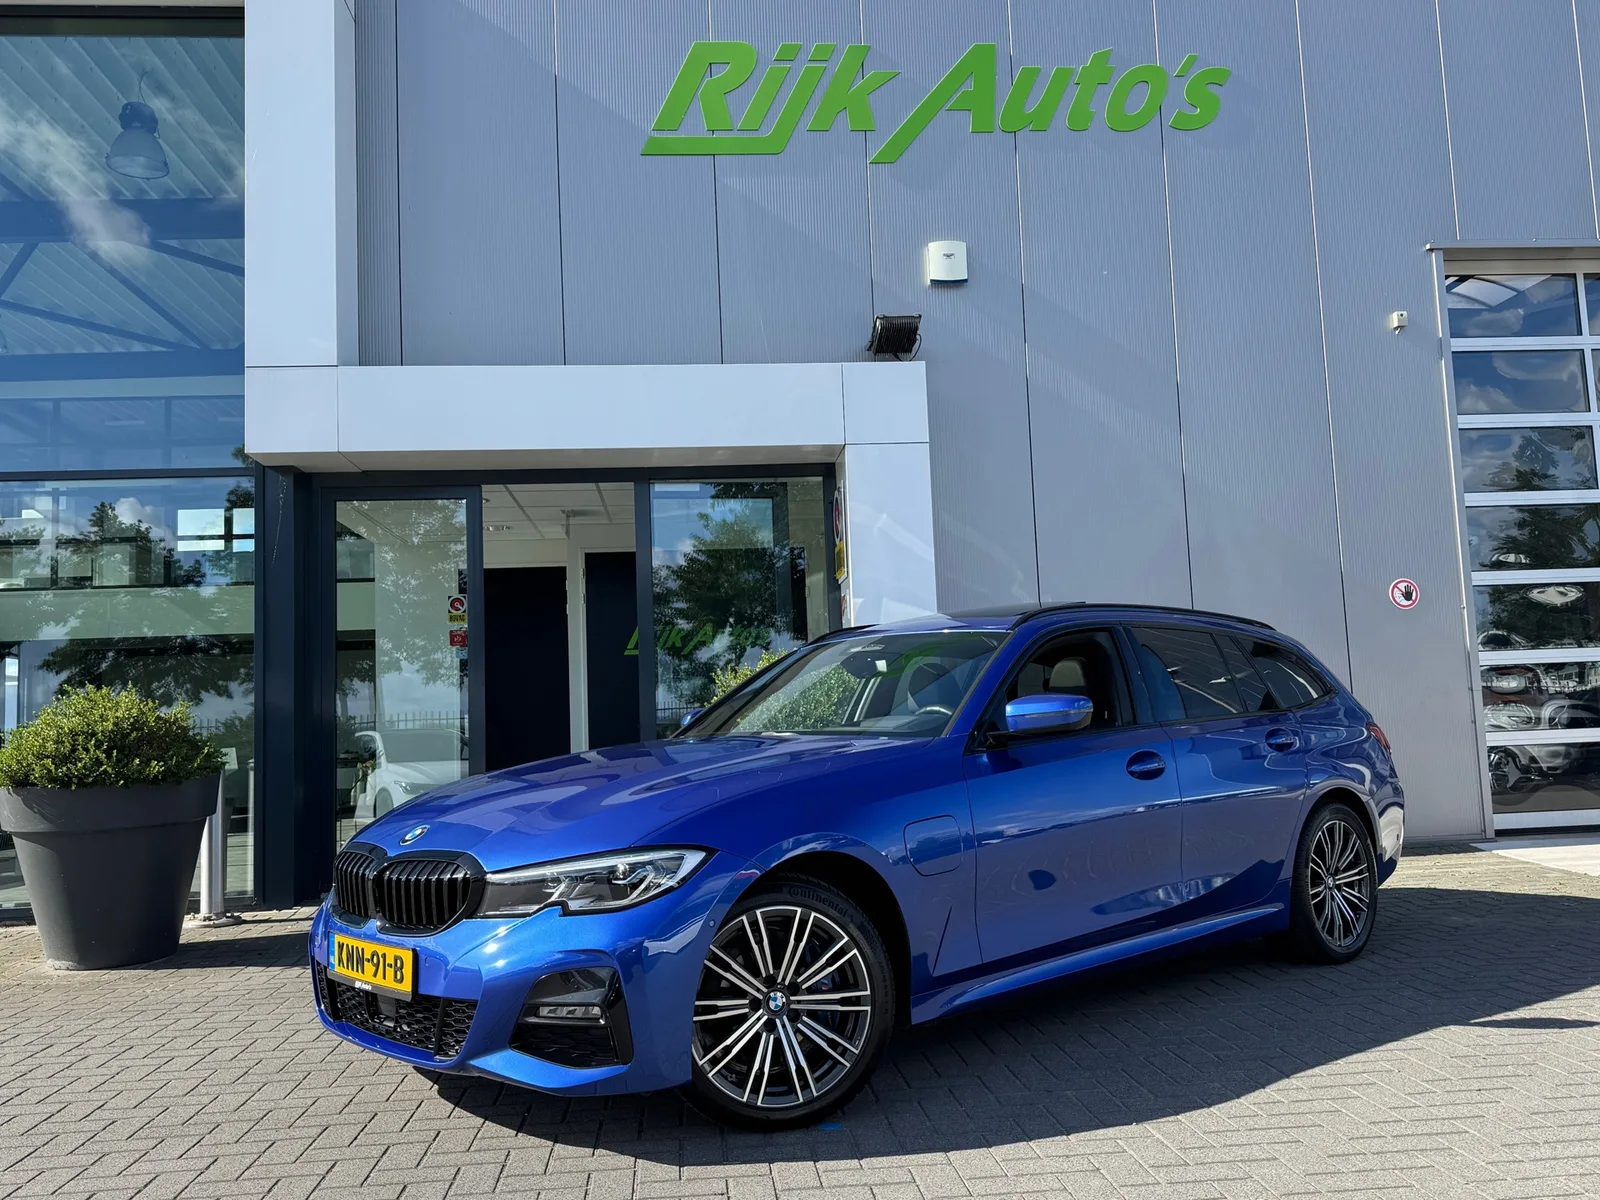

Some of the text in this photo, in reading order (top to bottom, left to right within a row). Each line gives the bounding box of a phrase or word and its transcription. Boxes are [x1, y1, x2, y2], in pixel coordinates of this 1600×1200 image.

[640, 41, 1231, 164] Rijk Auto's
[788, 885, 849, 918] Continental
[337, 940, 405, 985] KNN-91-B
